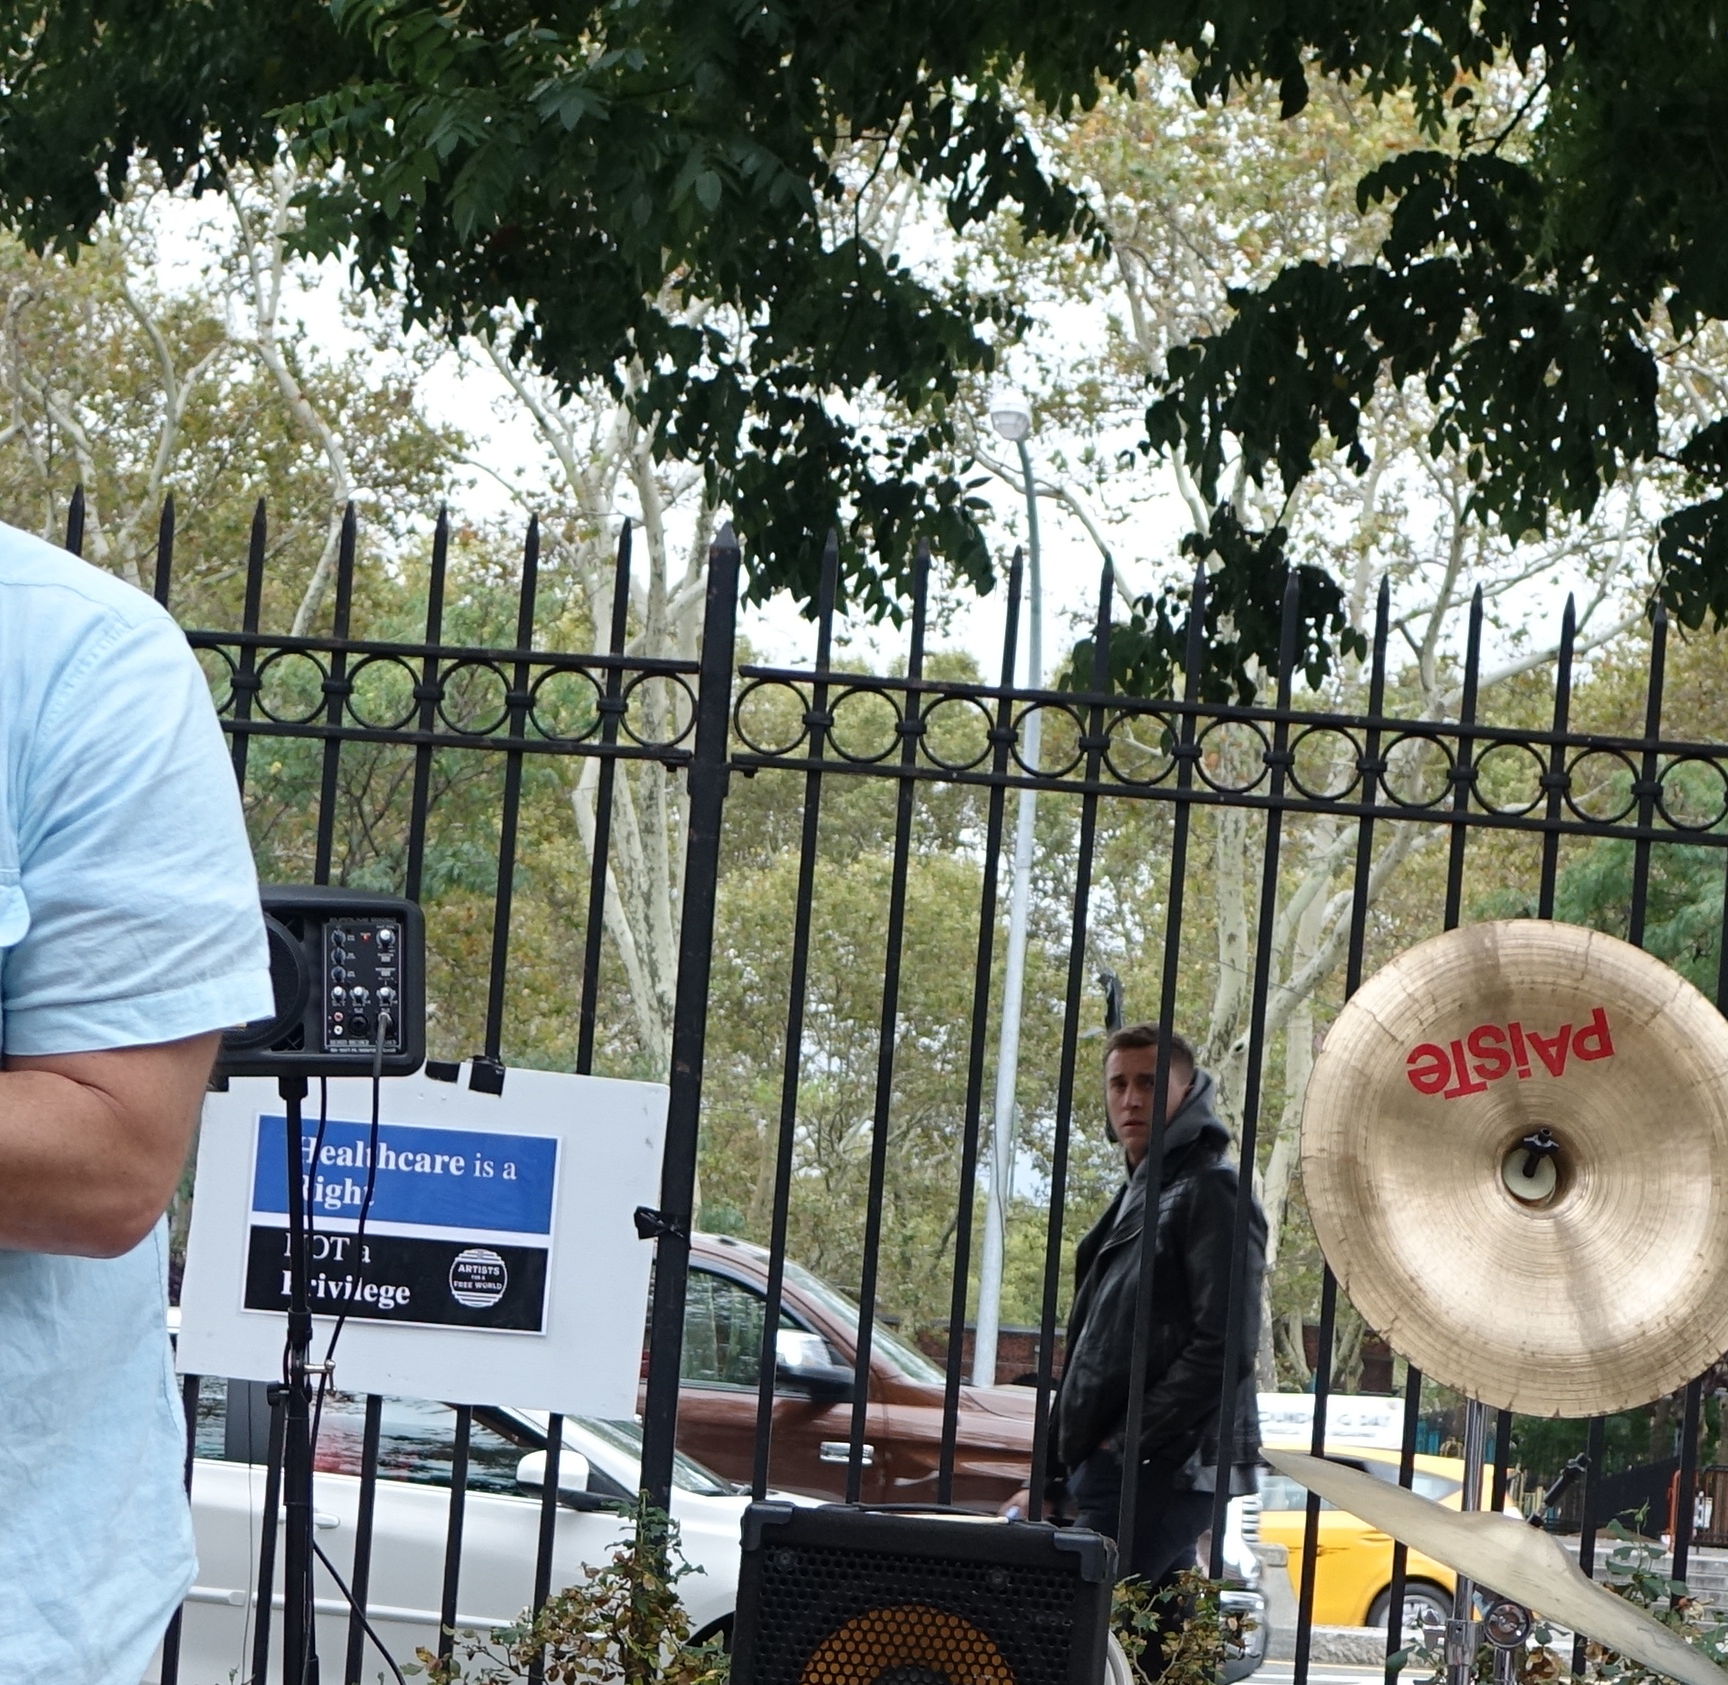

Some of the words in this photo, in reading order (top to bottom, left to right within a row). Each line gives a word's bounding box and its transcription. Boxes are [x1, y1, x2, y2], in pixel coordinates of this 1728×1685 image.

[473, 1153, 494, 1177] is
[502, 1160, 517, 1180] a
[458, 1263, 500, 1276] ARTISTS
[280, 1269, 411, 1309] ivilege
[453, 1280, 473, 1289] FREE
[475, 1281, 503, 1291] WORLD
